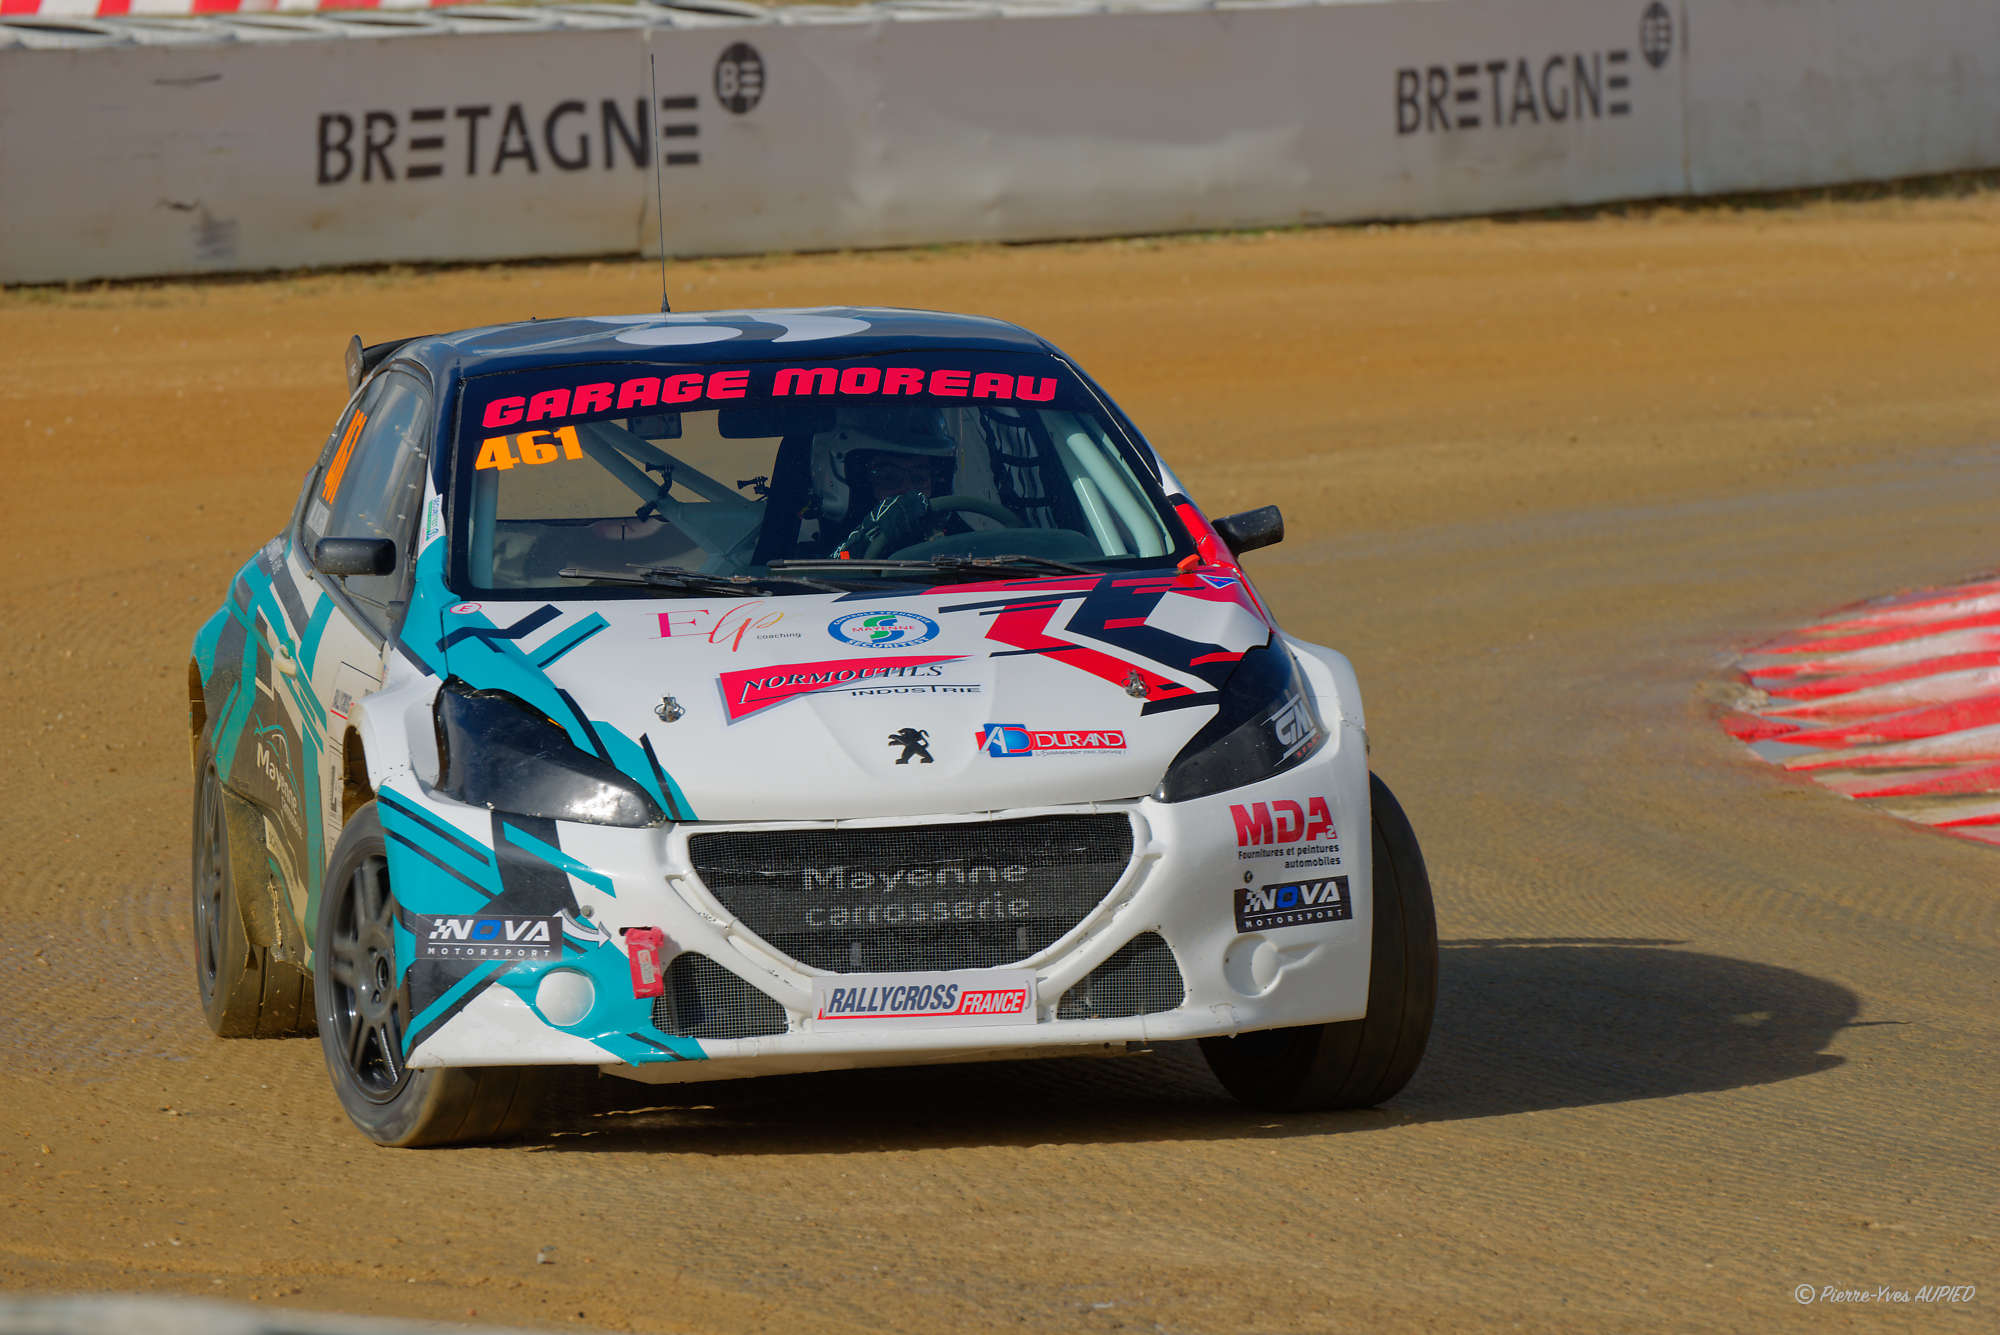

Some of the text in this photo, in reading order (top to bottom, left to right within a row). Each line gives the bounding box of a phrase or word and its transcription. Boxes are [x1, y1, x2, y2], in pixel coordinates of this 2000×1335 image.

[1396, 49, 1631, 135] BRETAGNE
[317, 96, 700, 185] BRETAGNE
[482, 367, 1058, 428] GARAGE MOREAU
[475, 425, 584, 471] 461
[756, 632, 802, 641] coaching
[738, 665, 943, 704] NORMOUTILS
[851, 684, 982, 696] INDUSTRIE
[1035, 732, 1124, 748] DURAND
[1238, 843, 1340, 860] Fournitures et peintures
[1284, 856, 1341, 869] automobiles
[802, 865, 1028, 891] Mayenne
[805, 891, 1030, 926] carrosserie
[1252, 881, 1341, 910] NOVA
[441, 919, 550, 941] NOVA
[1245, 909, 1344, 928] MOTORSPORT
[427, 947, 550, 957] MOTORSPORT
[828, 983, 1025, 1013] RALLYCROSS FRANCE
